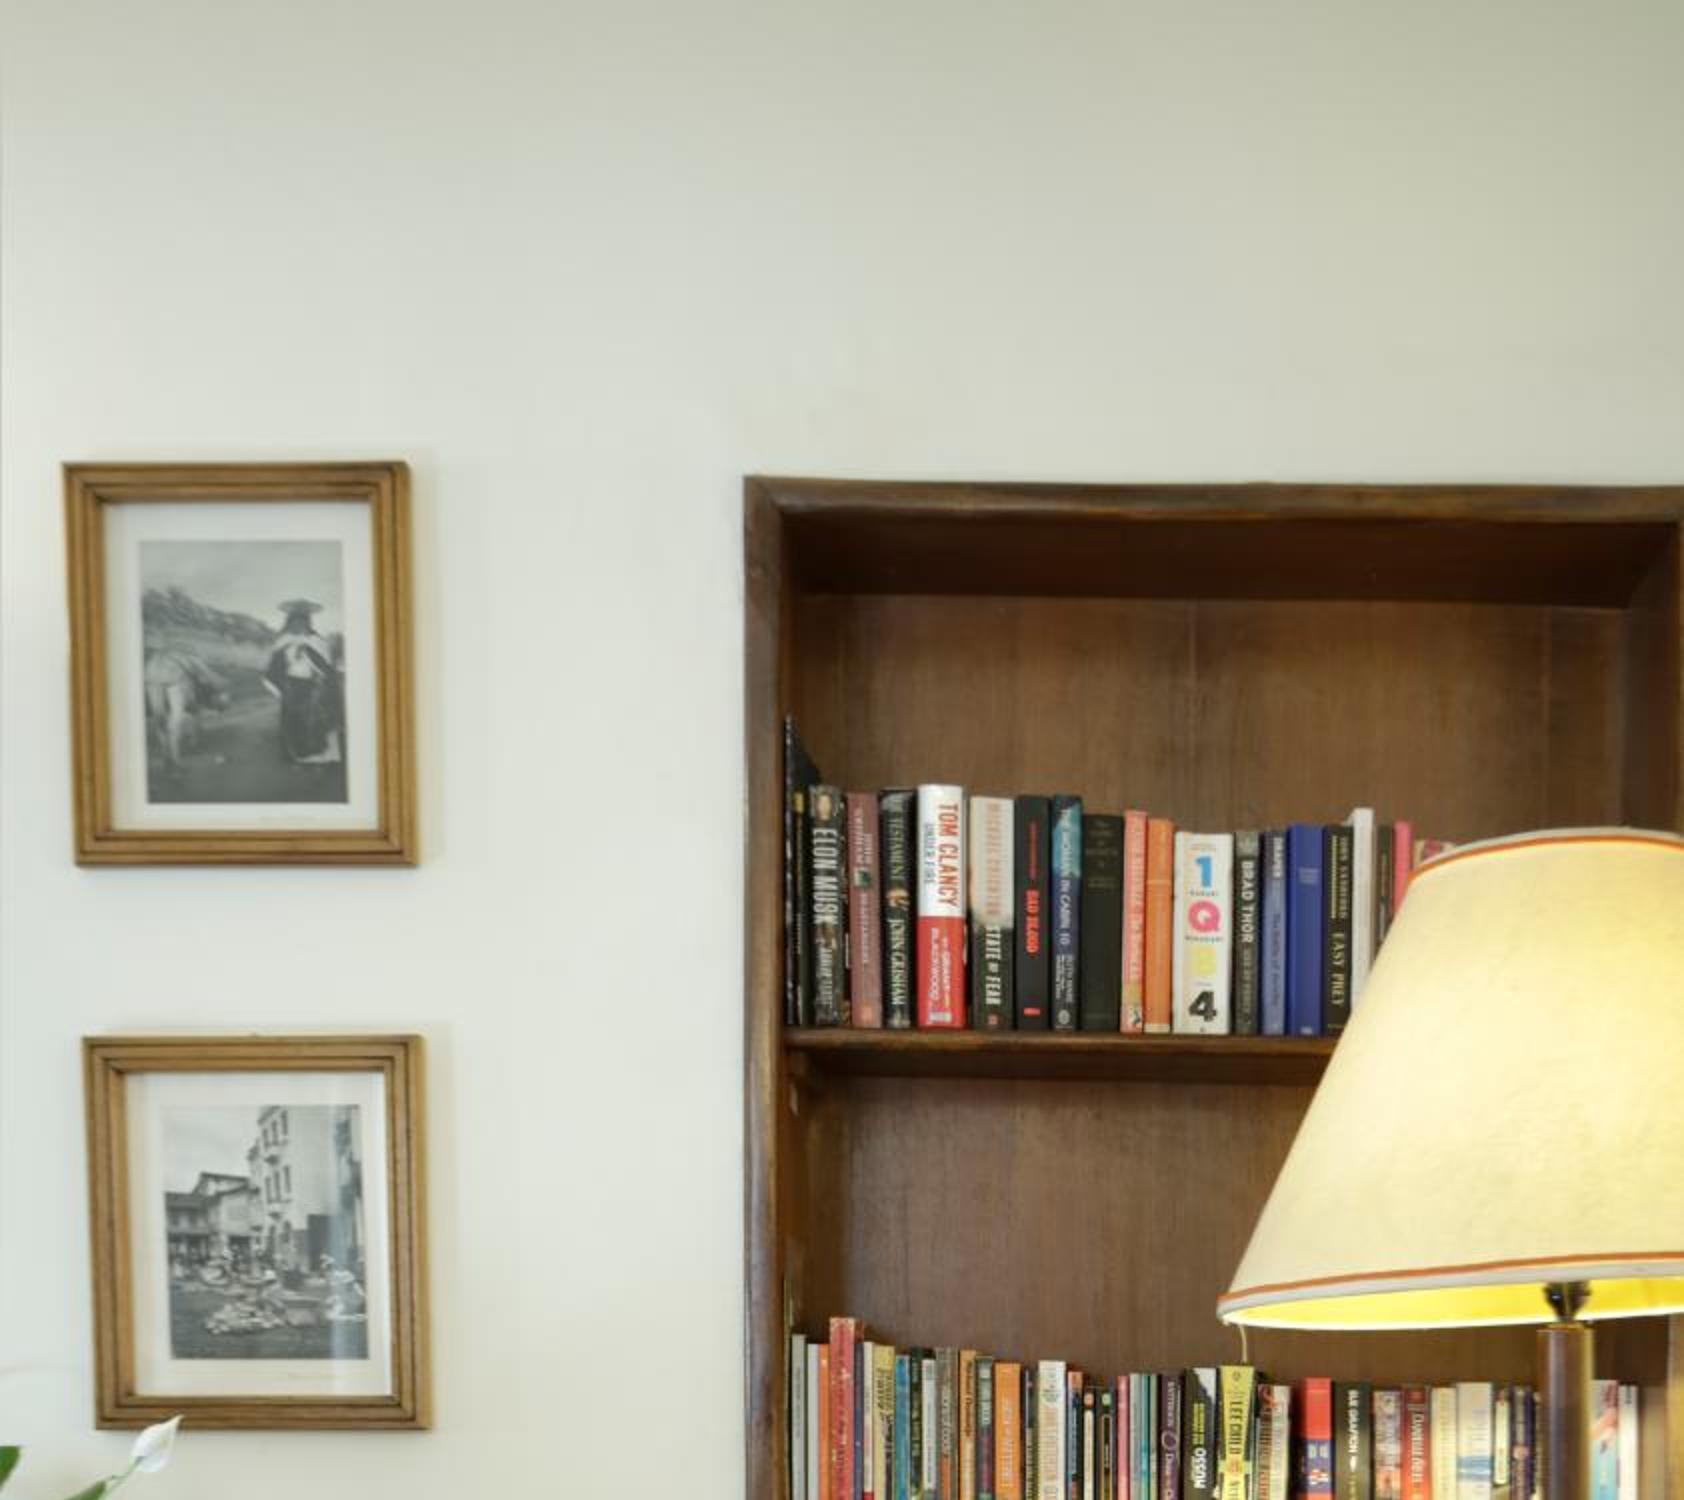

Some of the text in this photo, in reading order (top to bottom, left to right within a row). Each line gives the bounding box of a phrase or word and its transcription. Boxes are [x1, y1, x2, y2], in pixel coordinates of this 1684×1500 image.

[939, 804, 959, 907] TOM CLANCY
[813, 827, 838, 926] ELON MUSK
[1187, 900, 1221, 933] Q
[1241, 861, 1255, 943] BRAD THOR
[985, 925, 1001, 960] STATE
[1060, 933, 1070, 945] 10
[888, 918, 906, 1005] JOHN GRISHAM
[1331, 932, 1345, 1008] EASY PREY
[985, 976, 1001, 1005] FEAR
[1188, 990, 1217, 1023] 4
[1229, 1401, 1243, 1420] LEE
